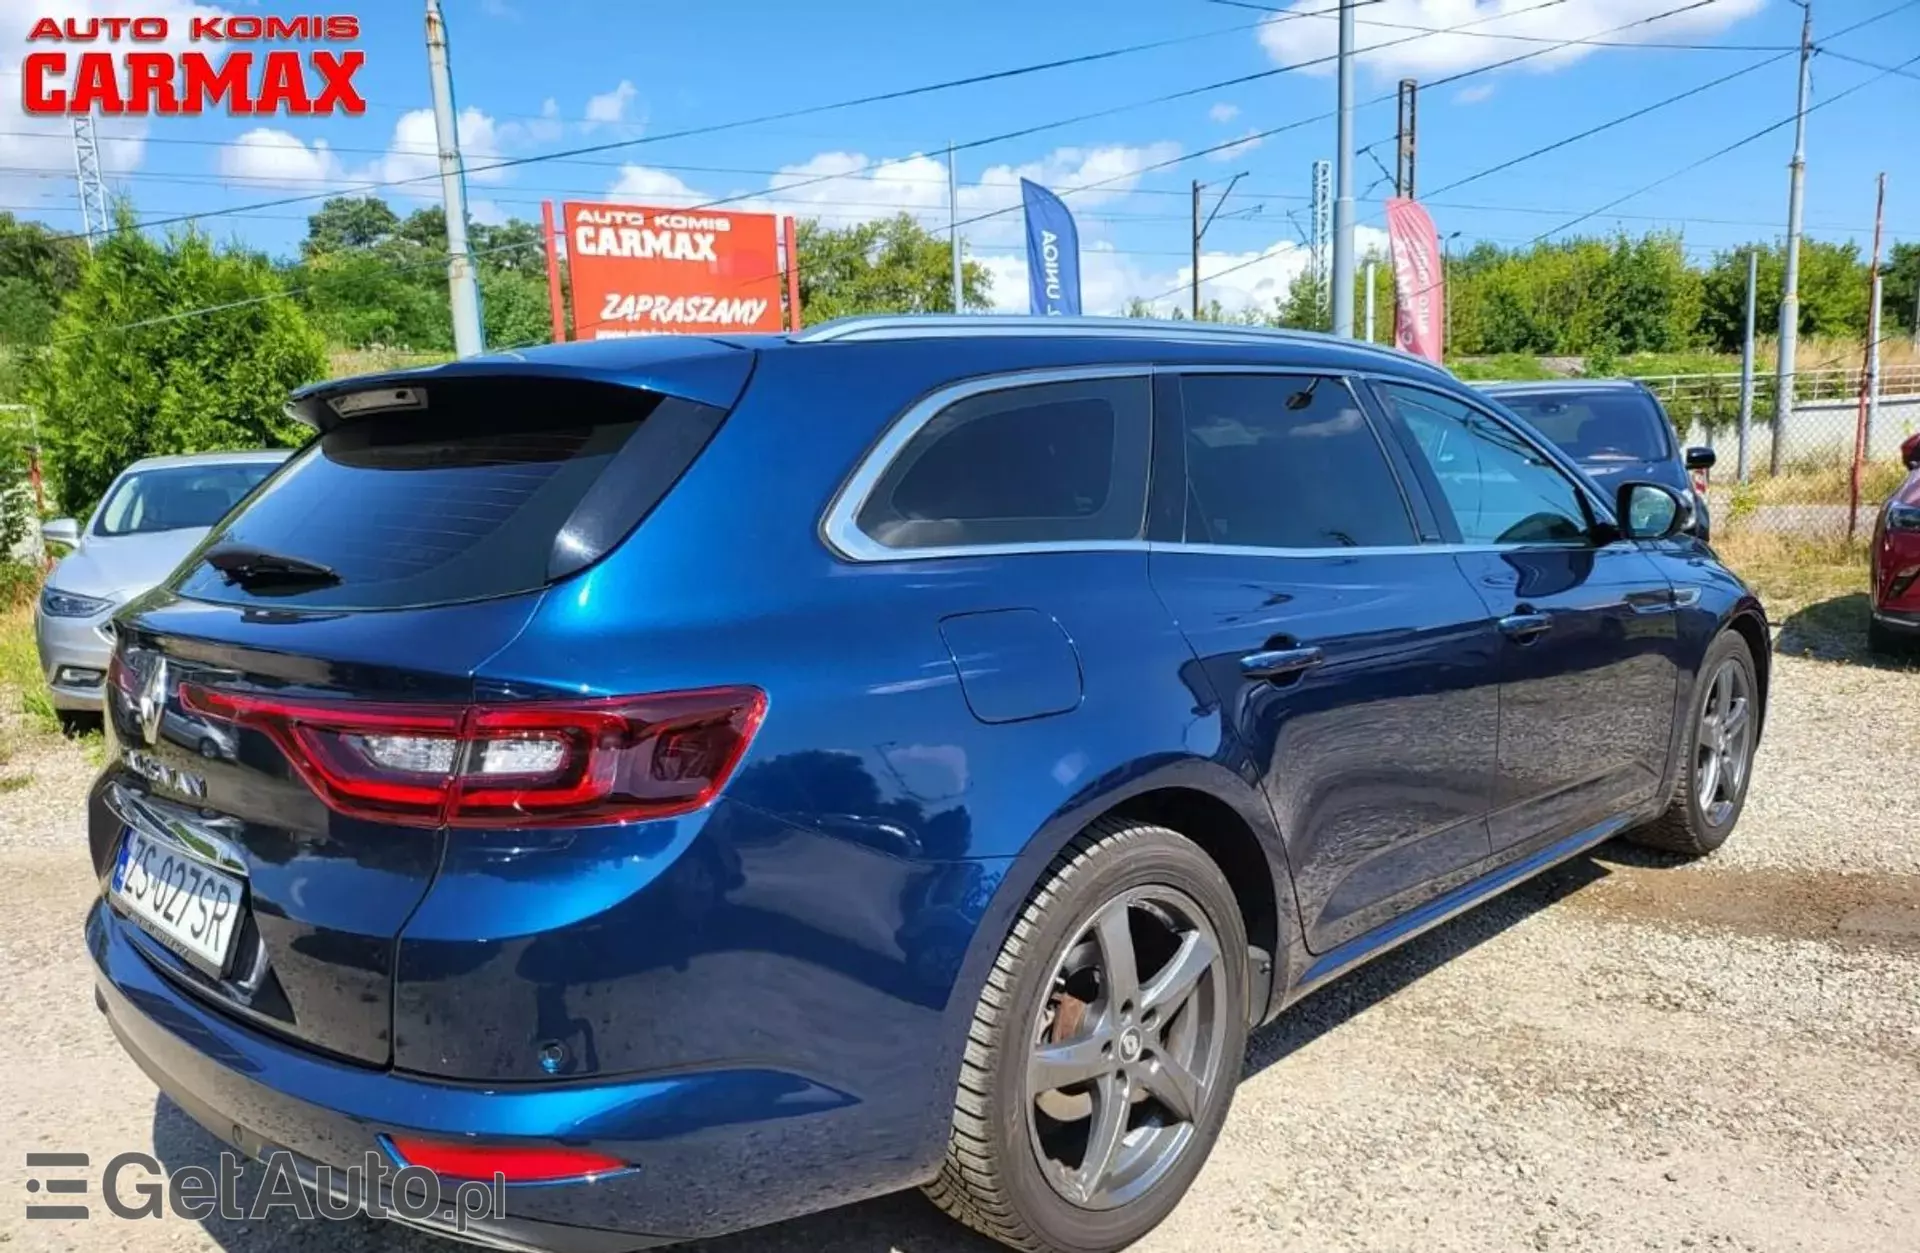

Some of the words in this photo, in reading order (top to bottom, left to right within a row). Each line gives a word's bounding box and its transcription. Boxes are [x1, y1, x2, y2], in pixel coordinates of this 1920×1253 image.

[576, 209, 645, 226] AUTO
[653, 214, 731, 232] KOMIS
[575, 225, 717, 262] CARMAX
[600, 293, 768, 325] ZAPRASZAMY
[152, 855, 232, 953] 027SR
